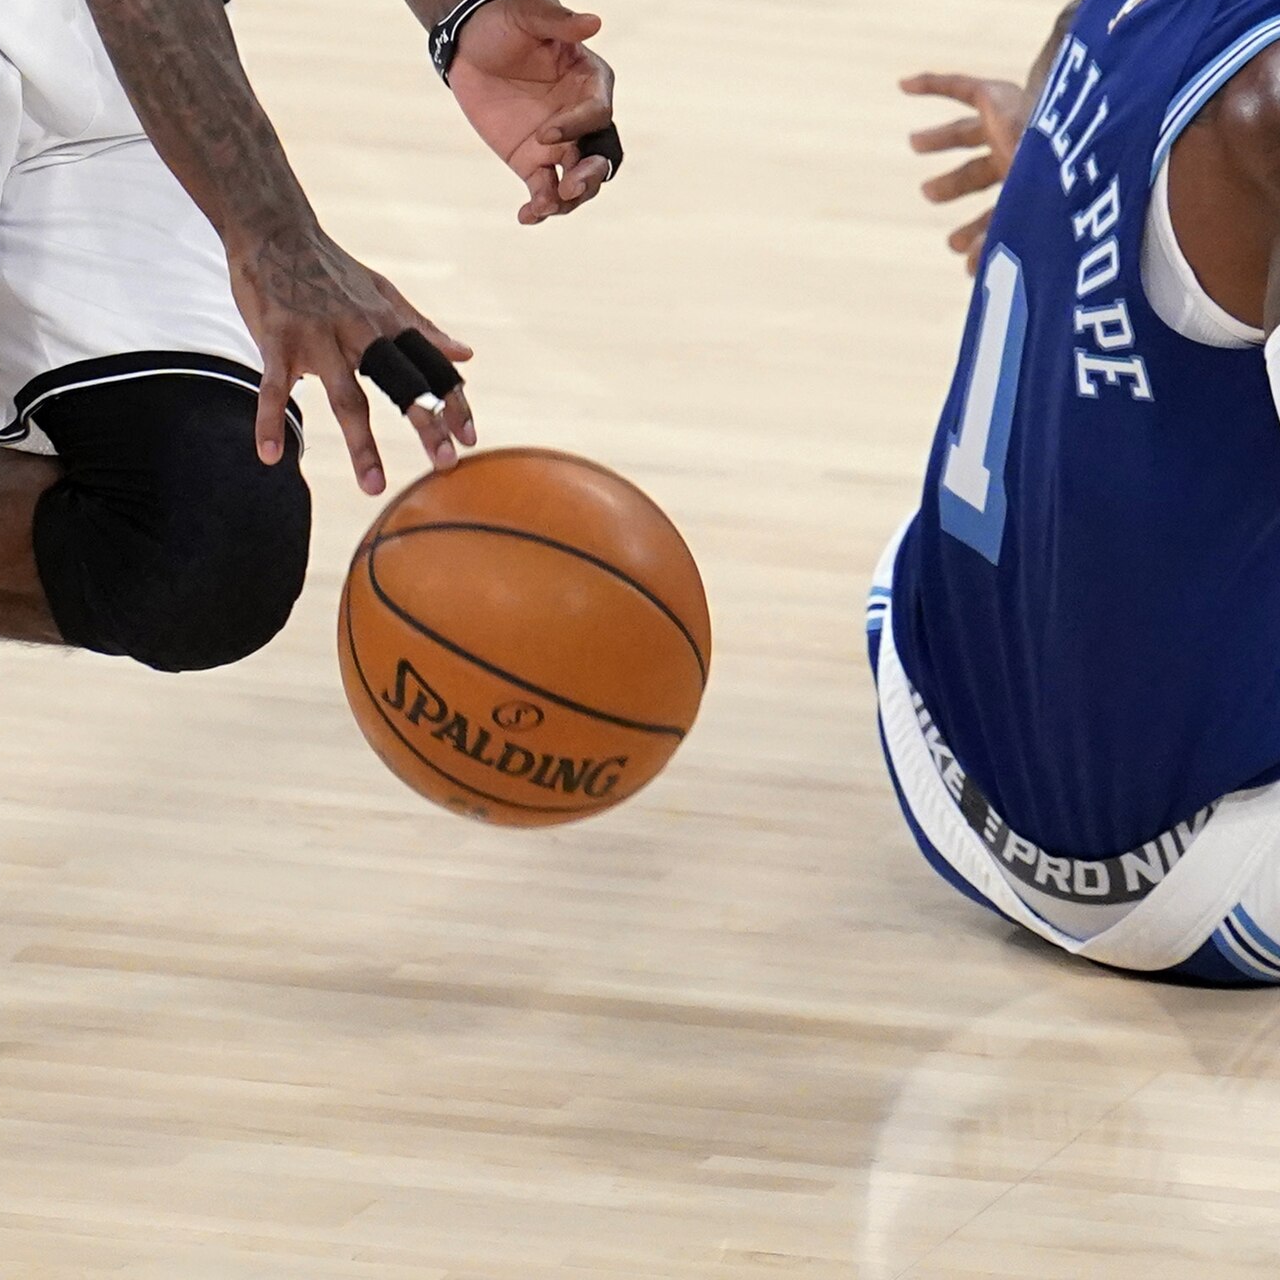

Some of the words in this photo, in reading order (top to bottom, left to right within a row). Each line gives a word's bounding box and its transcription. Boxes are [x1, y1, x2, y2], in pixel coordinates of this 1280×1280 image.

[1030, 33, 1155, 402] ELL-POPE
[381, 658, 629, 797] SPALDING
[1002, 828, 1111, 897] PRO
